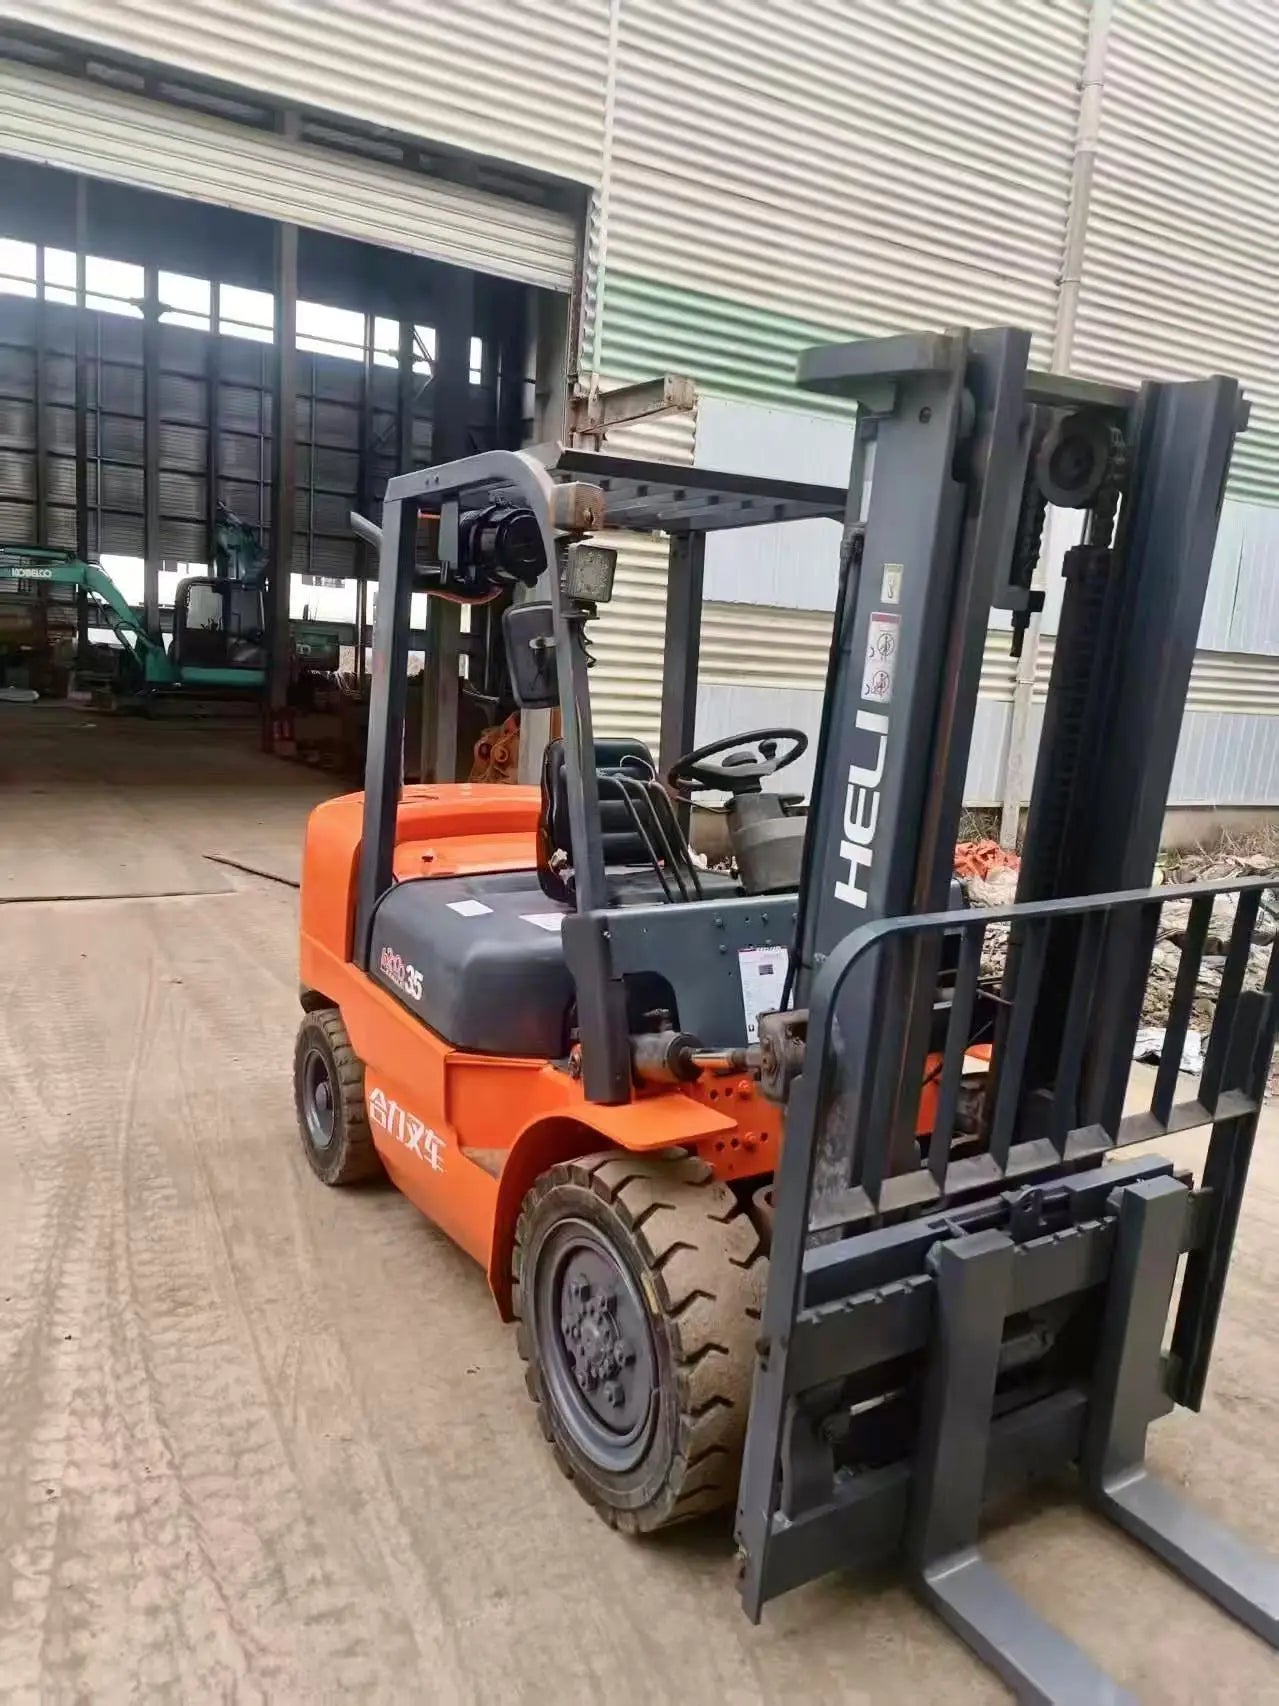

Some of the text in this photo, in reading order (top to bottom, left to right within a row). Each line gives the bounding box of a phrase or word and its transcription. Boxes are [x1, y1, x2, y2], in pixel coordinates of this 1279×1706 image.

[11, 567, 52, 578] KOBELCO
[834, 710, 889, 909] HELI
[405, 964, 424, 1001] 35
[369, 1087, 446, 1174] 合力叉车
